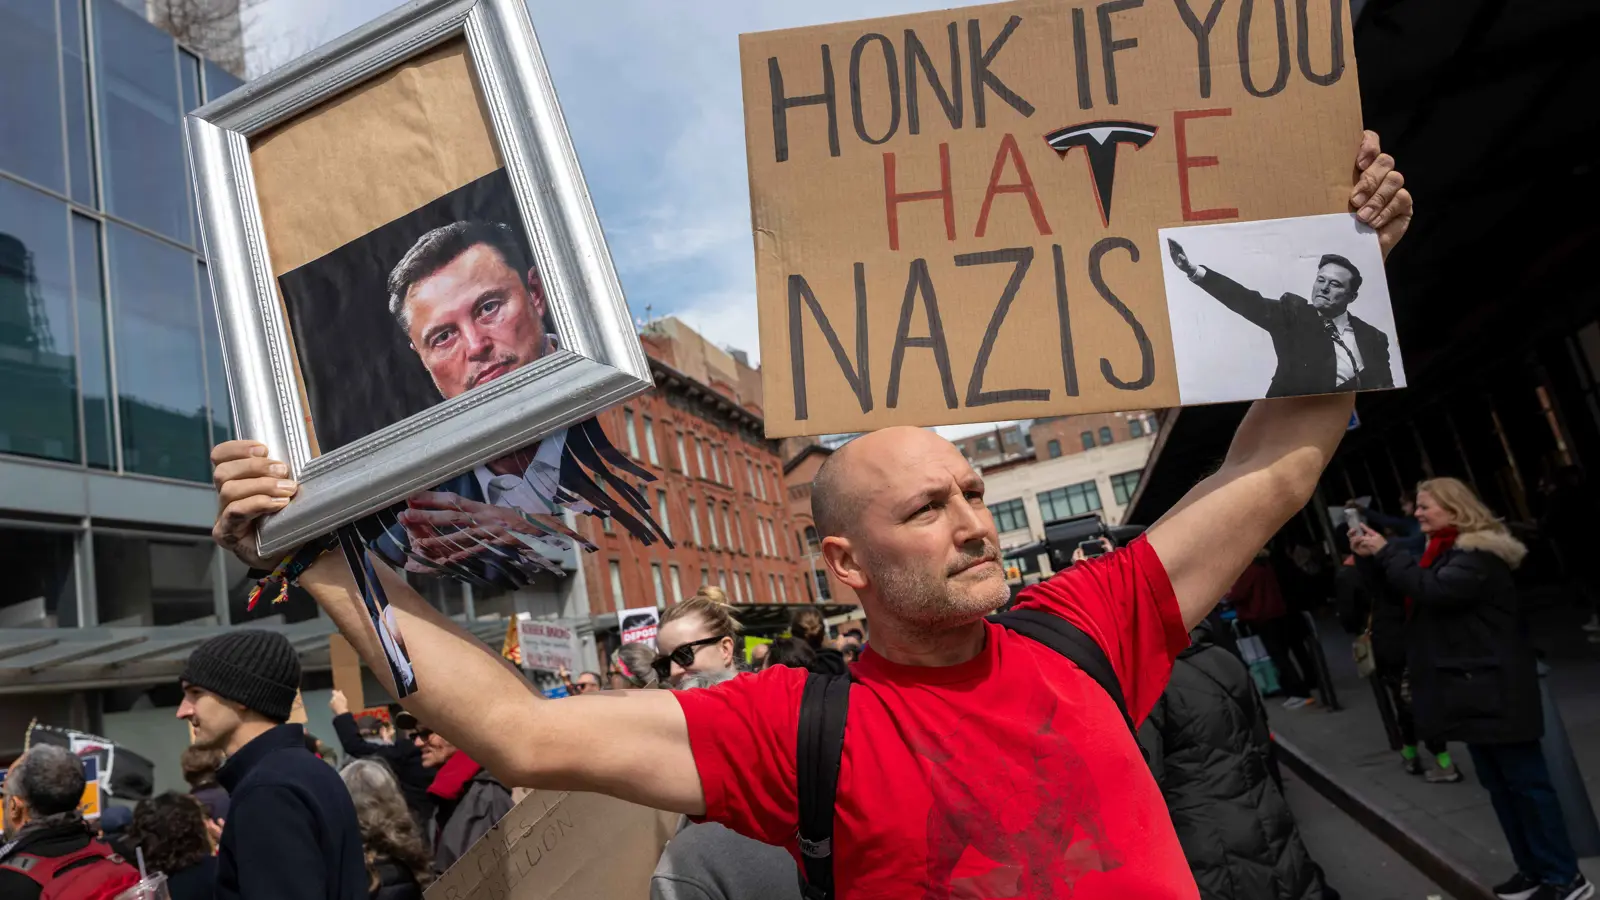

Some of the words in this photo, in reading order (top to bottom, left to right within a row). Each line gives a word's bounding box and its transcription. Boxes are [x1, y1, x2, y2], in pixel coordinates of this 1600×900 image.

[768, 15, 1035, 163] HONK
[1071, 0, 1145, 110] IF
[1172, 0, 1345, 99] YOU
[883, 108, 1239, 251] HATE
[788, 237, 1155, 421] NAZIS
